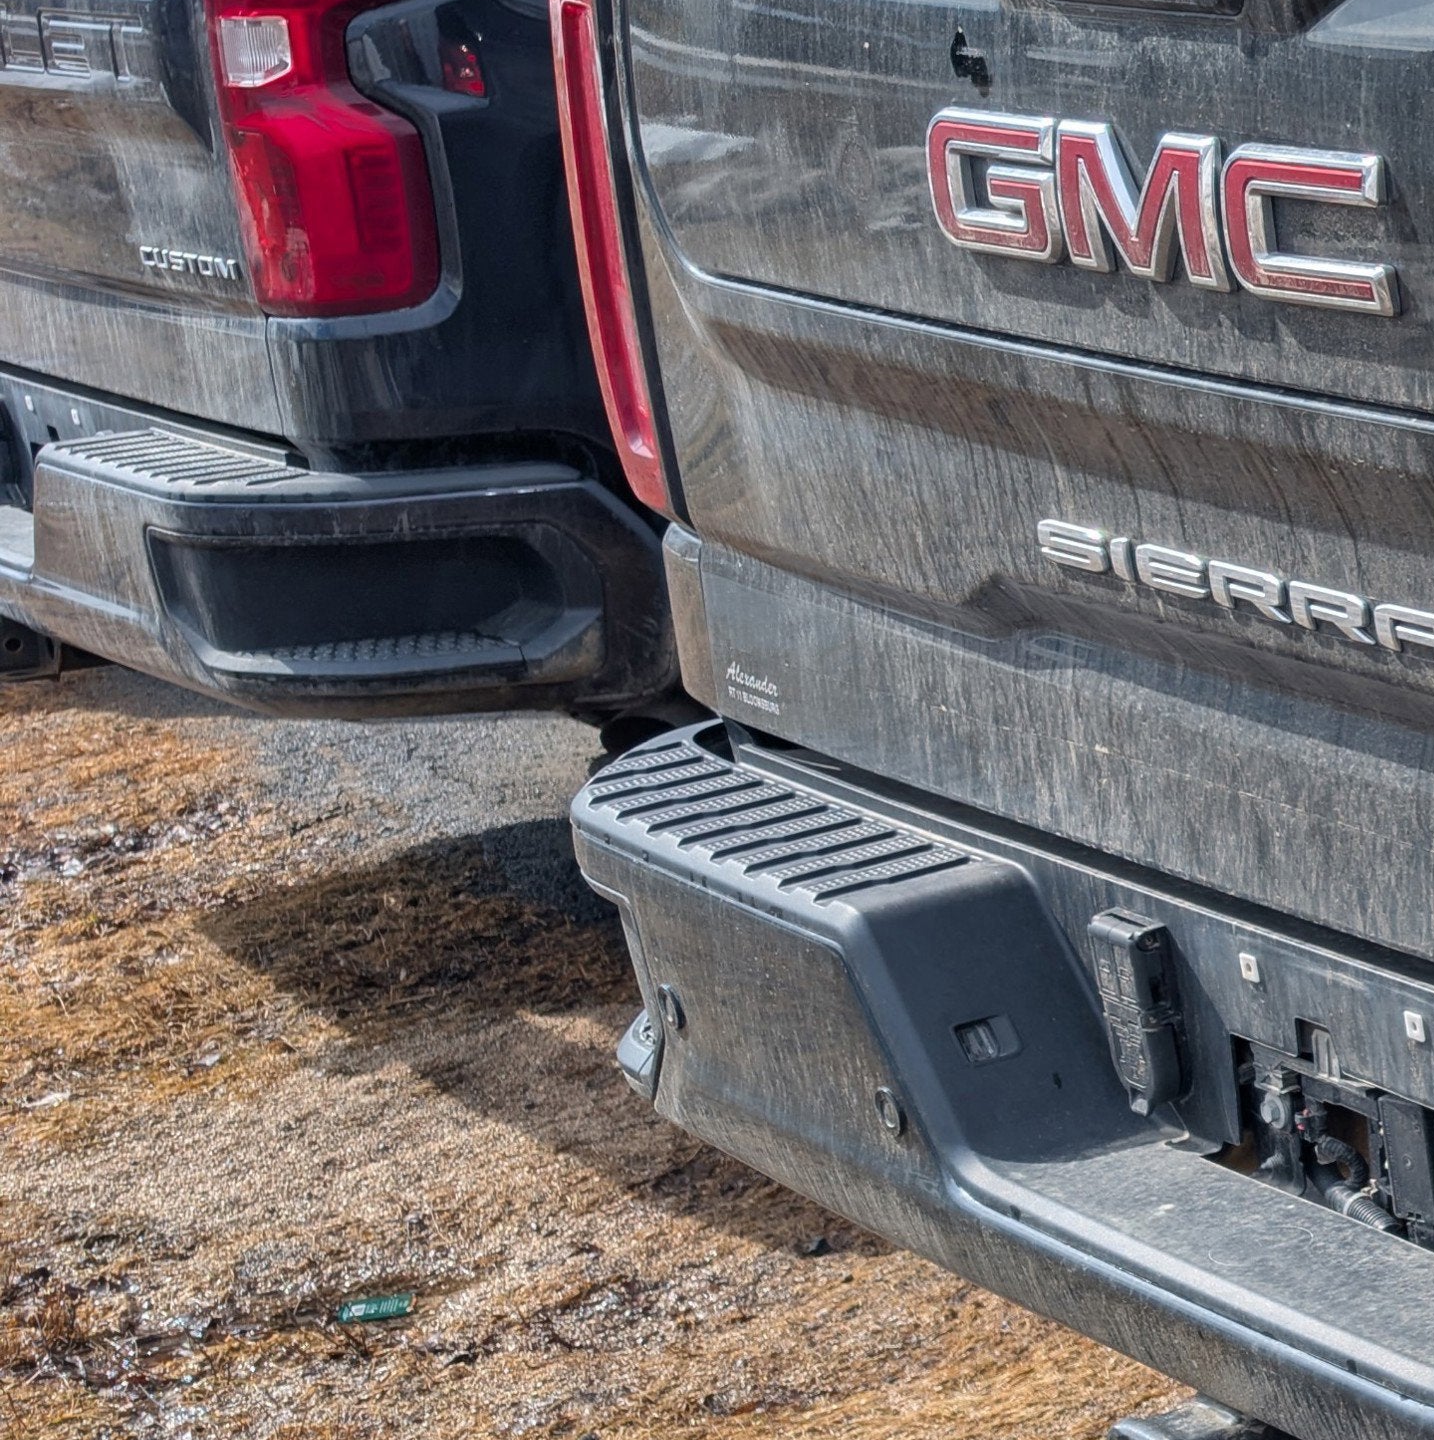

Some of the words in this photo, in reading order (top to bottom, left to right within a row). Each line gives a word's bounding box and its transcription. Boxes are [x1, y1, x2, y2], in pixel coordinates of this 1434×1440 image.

[925, 105, 1401, 317] GMC
[140, 245, 241, 280] CUSTOM
[725, 661, 778, 697] Alexander
